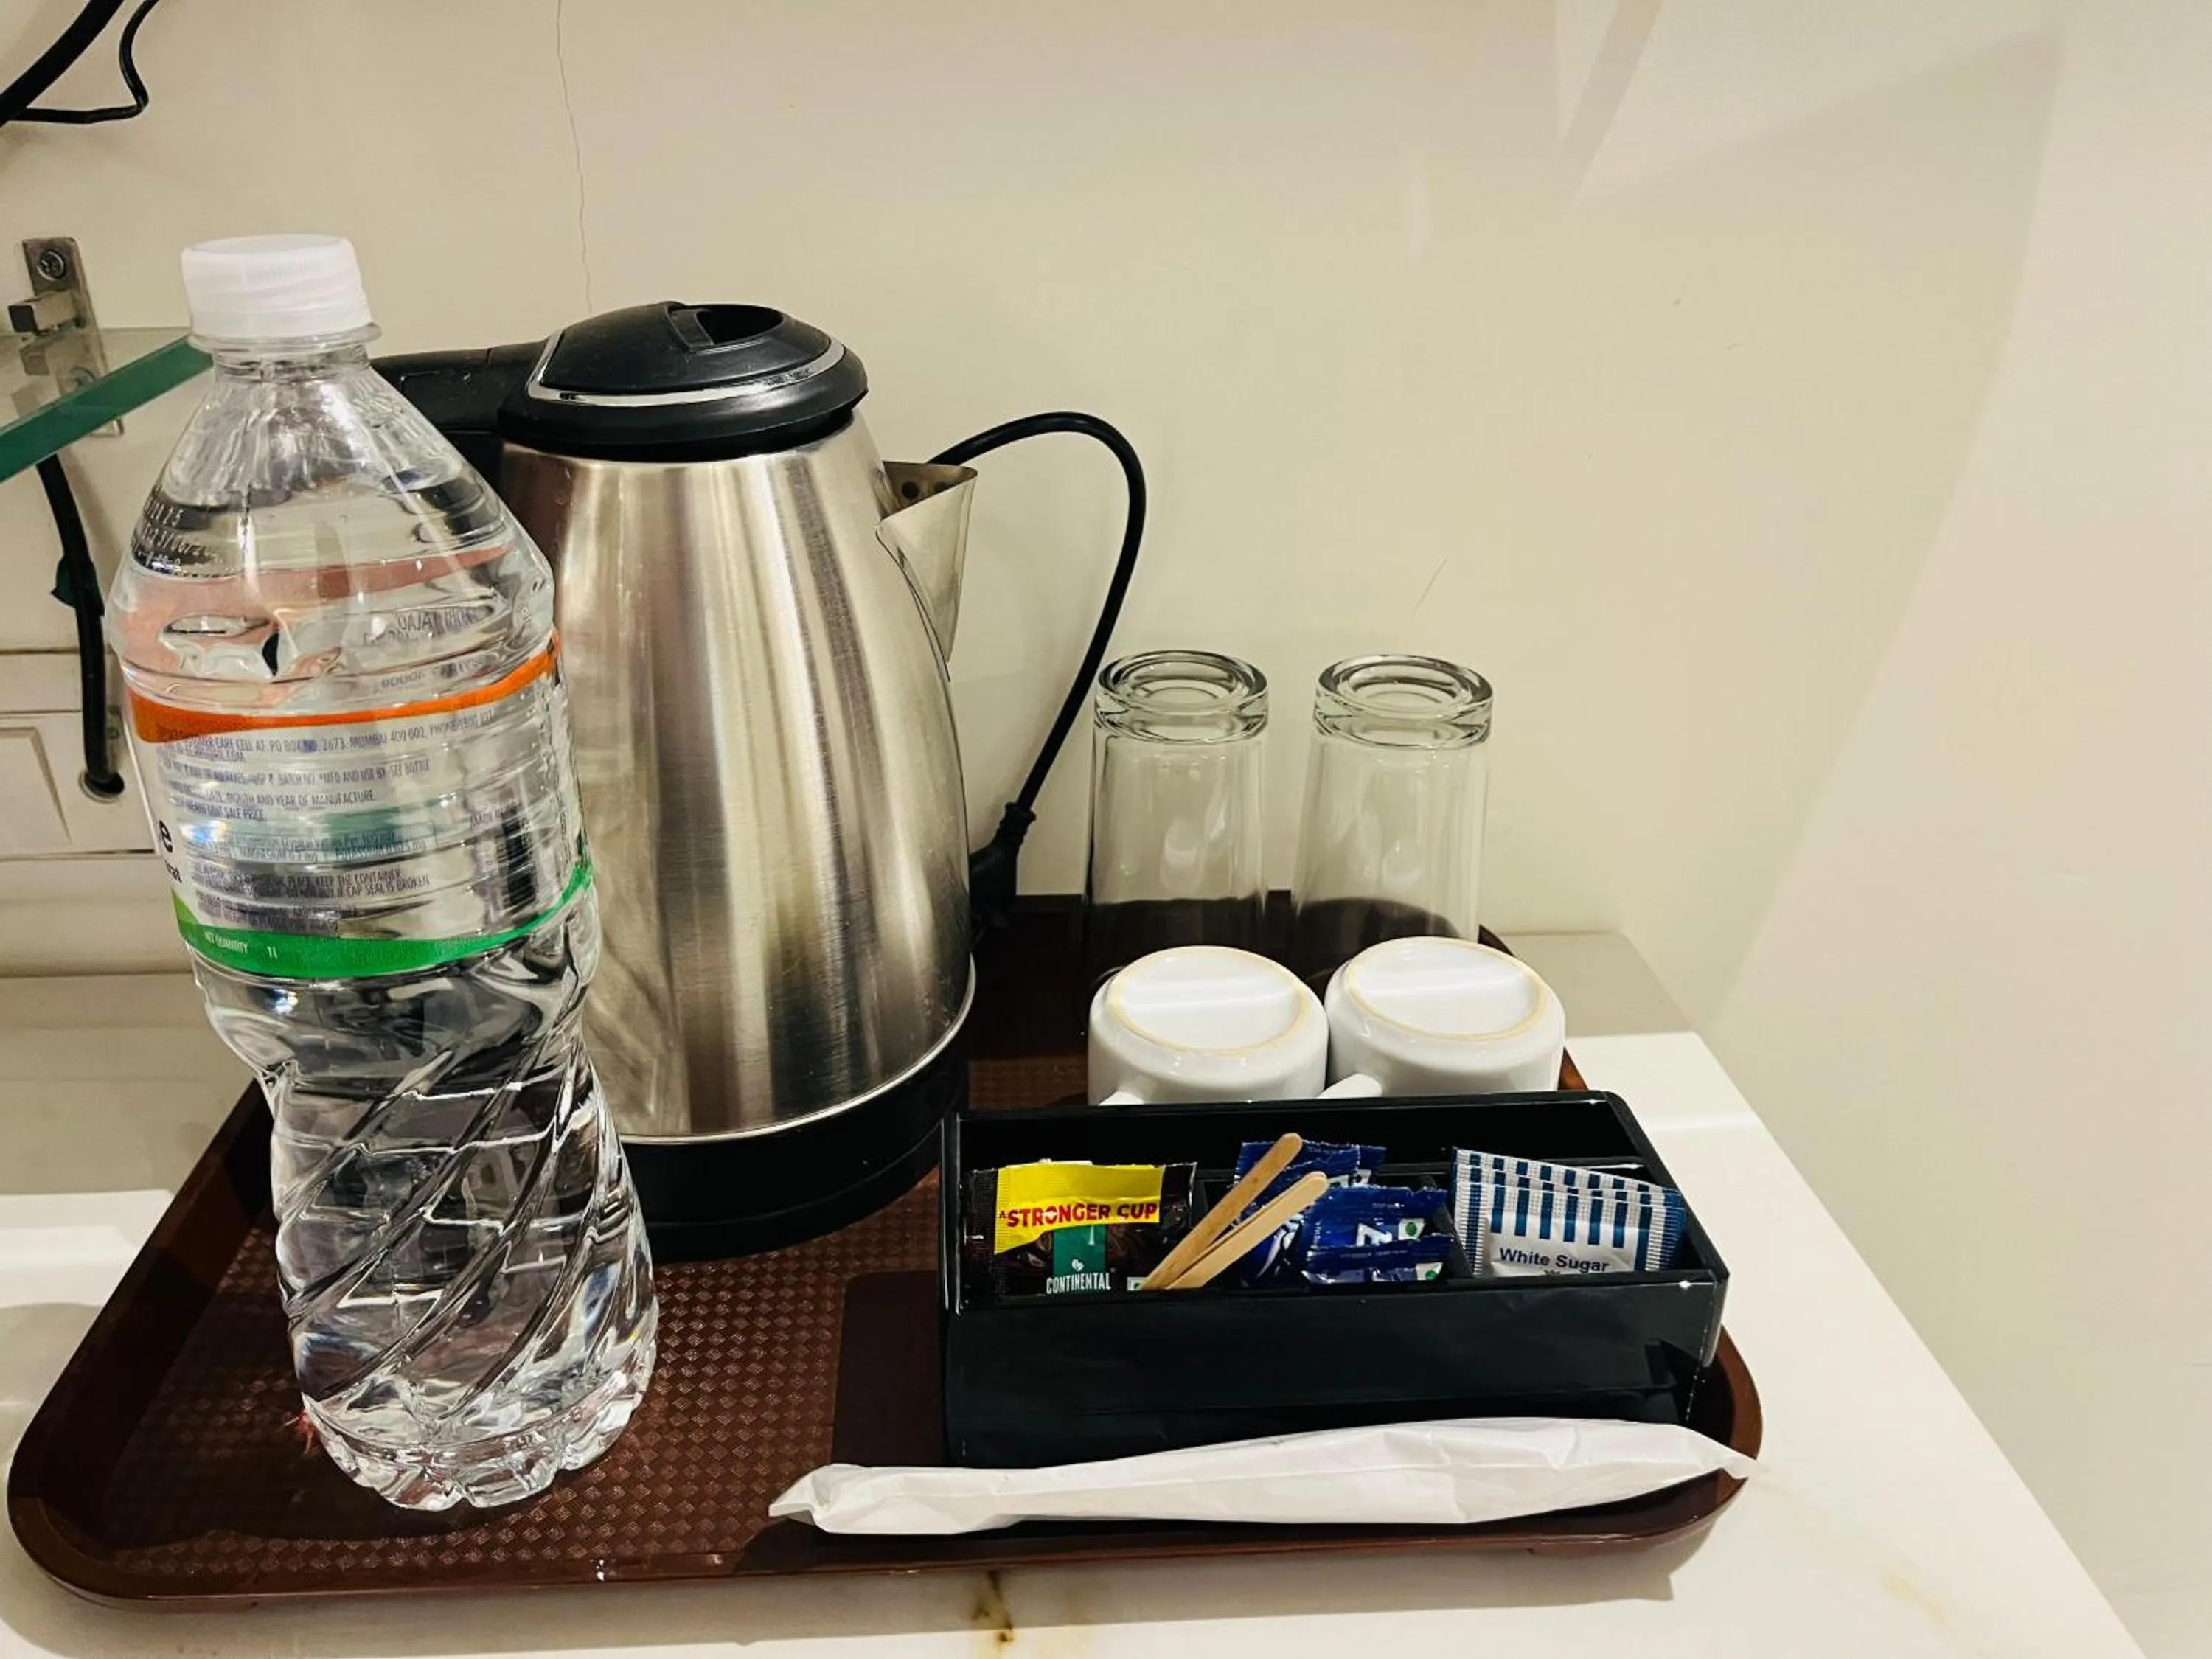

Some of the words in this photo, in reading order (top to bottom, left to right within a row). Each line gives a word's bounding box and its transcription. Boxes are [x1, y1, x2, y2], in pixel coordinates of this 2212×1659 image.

[271, 740, 282, 752] PO
[366, 881, 384, 895] SEAL
[1007, 1203, 1111, 1227] STRONGER
[1117, 1203, 1158, 1220] CUP
[1500, 1248, 1551, 1266] White
[1556, 1254, 1610, 1273] Sugar
[1046, 1272, 1111, 1294] CONTINENTAL
